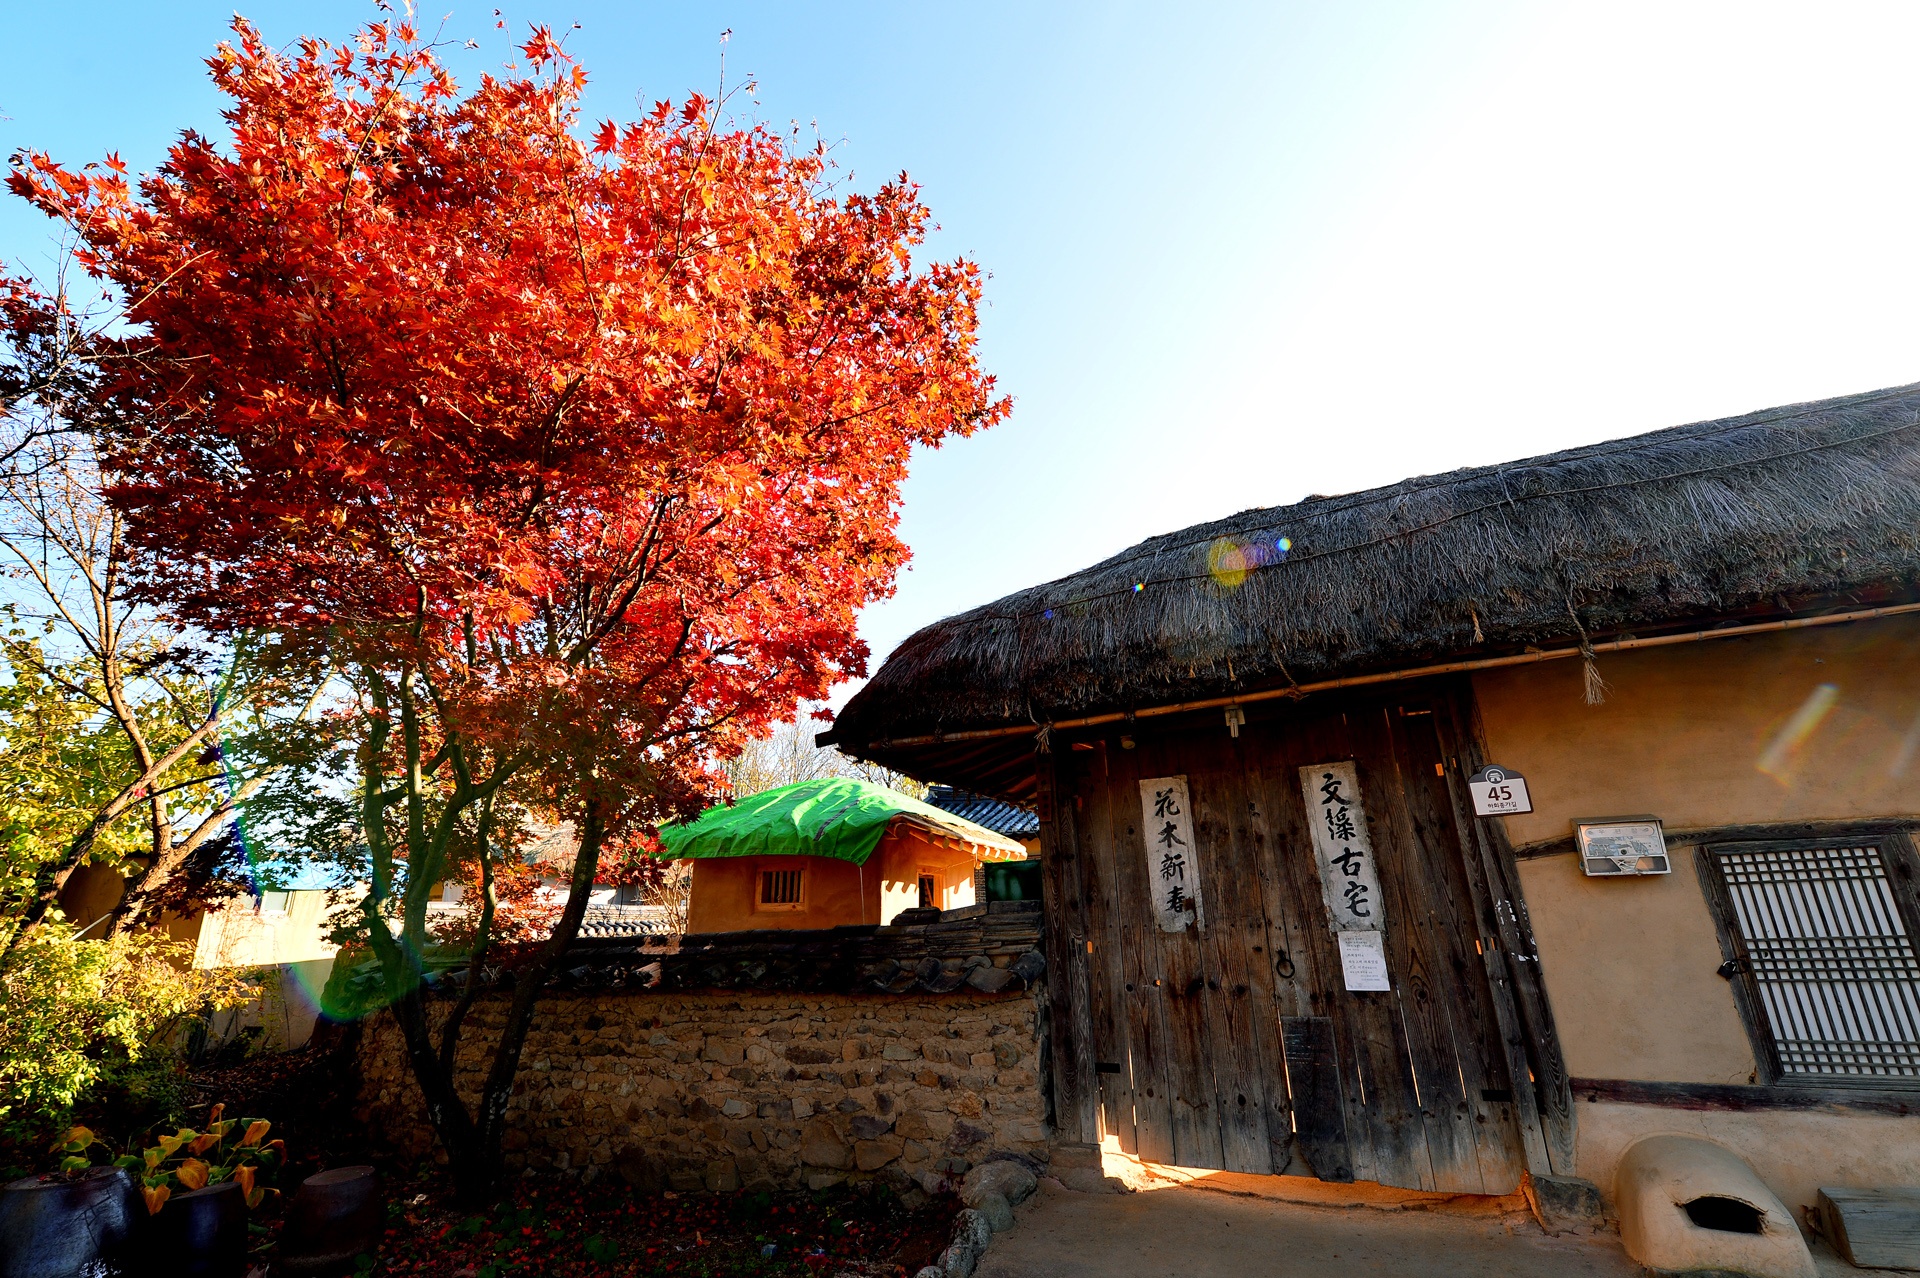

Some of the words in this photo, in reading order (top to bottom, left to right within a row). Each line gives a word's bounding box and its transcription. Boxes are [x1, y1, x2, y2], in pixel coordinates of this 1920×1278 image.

[1487, 785, 1512, 801] 45
[1487, 801, 1517, 809] 하회종가길
[1154, 787, 1187, 914] 花木新春
